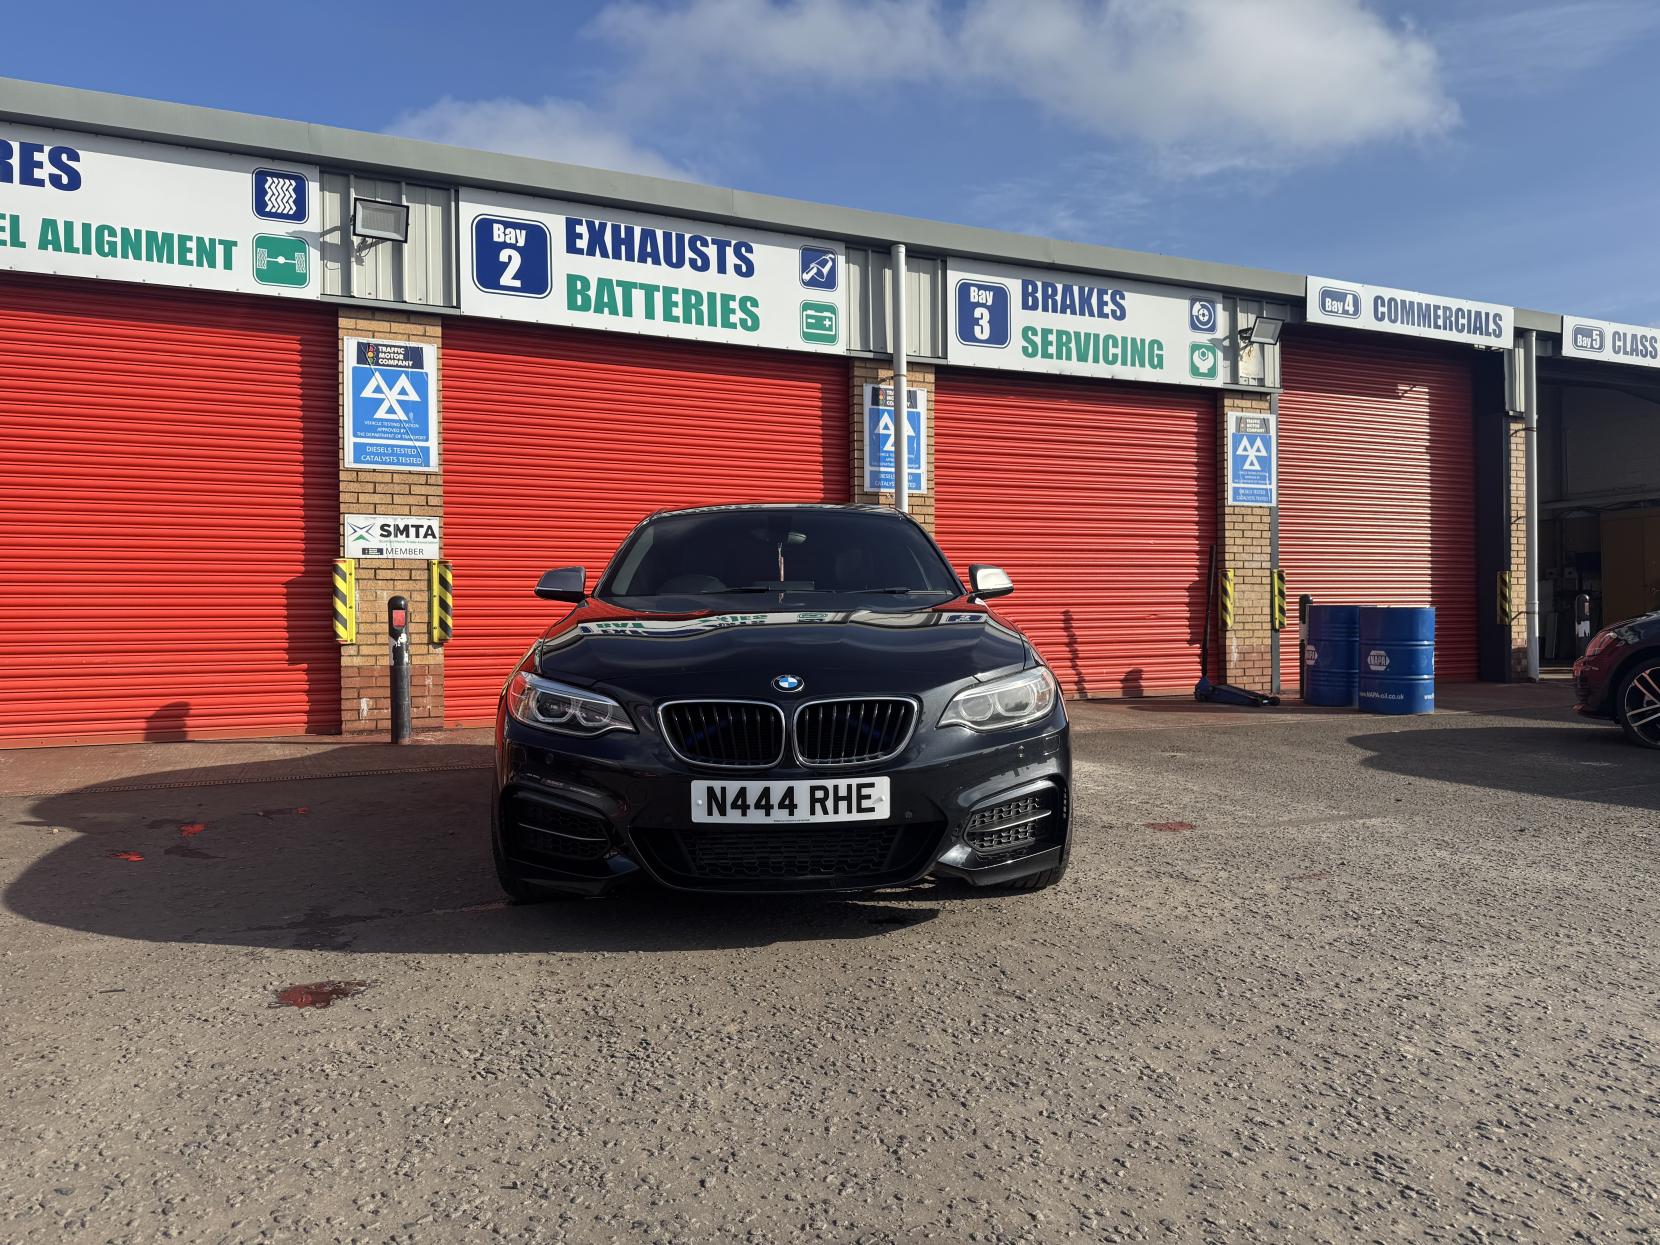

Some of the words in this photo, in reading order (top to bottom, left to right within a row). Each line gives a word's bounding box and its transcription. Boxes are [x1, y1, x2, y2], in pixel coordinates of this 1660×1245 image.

[38, 218, 238, 271] ALIGNMENT
[493, 223, 526, 247] Bay
[565, 217, 755, 278] EXHAUSTS
[499, 248, 521, 287] 2
[566, 273, 760, 332] BATTERIES
[970, 286, 993, 306] Bay
[1021, 279, 1127, 322] BRAKES
[1325, 297, 1343, 314] Bay
[1343, 294, 1354, 315] 4
[974, 307, 990, 340] 3
[1373, 295, 1503, 339] COMMERCIALS
[378, 346, 405, 354] TRAFFIC
[1021, 325, 1164, 370] SERVICING
[1577, 334, 1591, 348] Bay
[1592, 330, 1600, 348] 5
[1612, 331, 1658, 359] CLASS
[379, 359, 413, 367] COMPANY
[361, 455, 398, 463] CATALYSTS
[379, 523, 438, 539] SMTA
[385, 547, 424, 556] MEMBER
[1370, 655, 1387, 666] NAPA
[706, 785, 798, 817] N444
[809, 782, 876, 816] RHE
